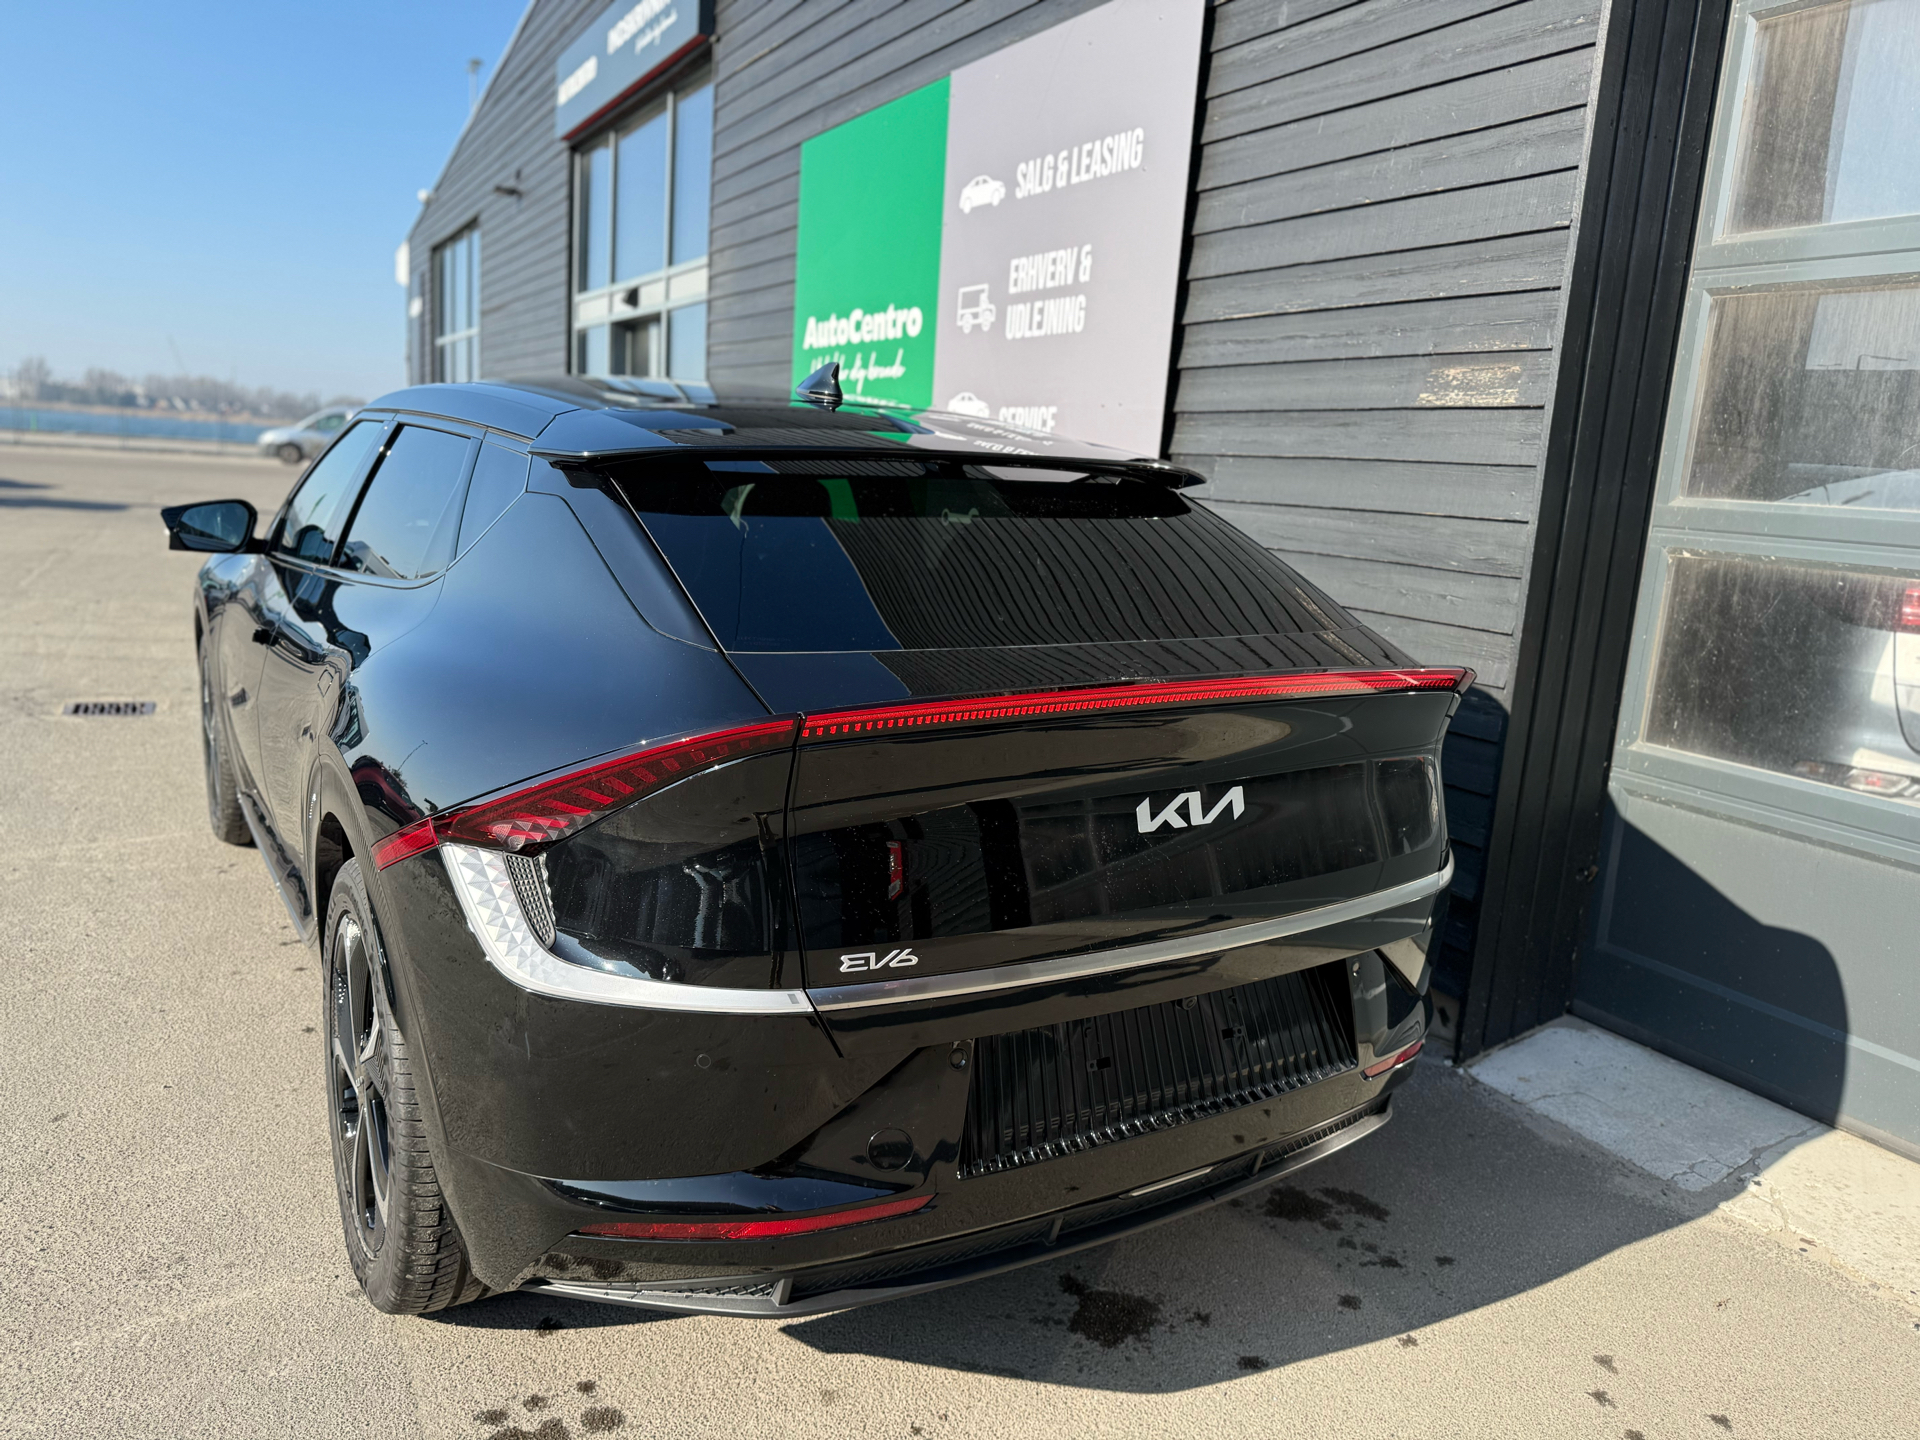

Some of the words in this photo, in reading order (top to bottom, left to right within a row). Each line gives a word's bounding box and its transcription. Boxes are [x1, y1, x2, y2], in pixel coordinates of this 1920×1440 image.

[1015, 154, 1054, 199] SALG
[1055, 149, 1069, 188] &
[1070, 127, 1144, 185] LEASING
[1008, 246, 1078, 294] ERHVERV
[1078, 244, 1092, 283] &
[802, 303, 923, 350] AutoCentro
[1005, 294, 1086, 340] UDLEJNING
[1136, 785, 1245, 833] KIA
[840, 948, 918, 972] EV6
